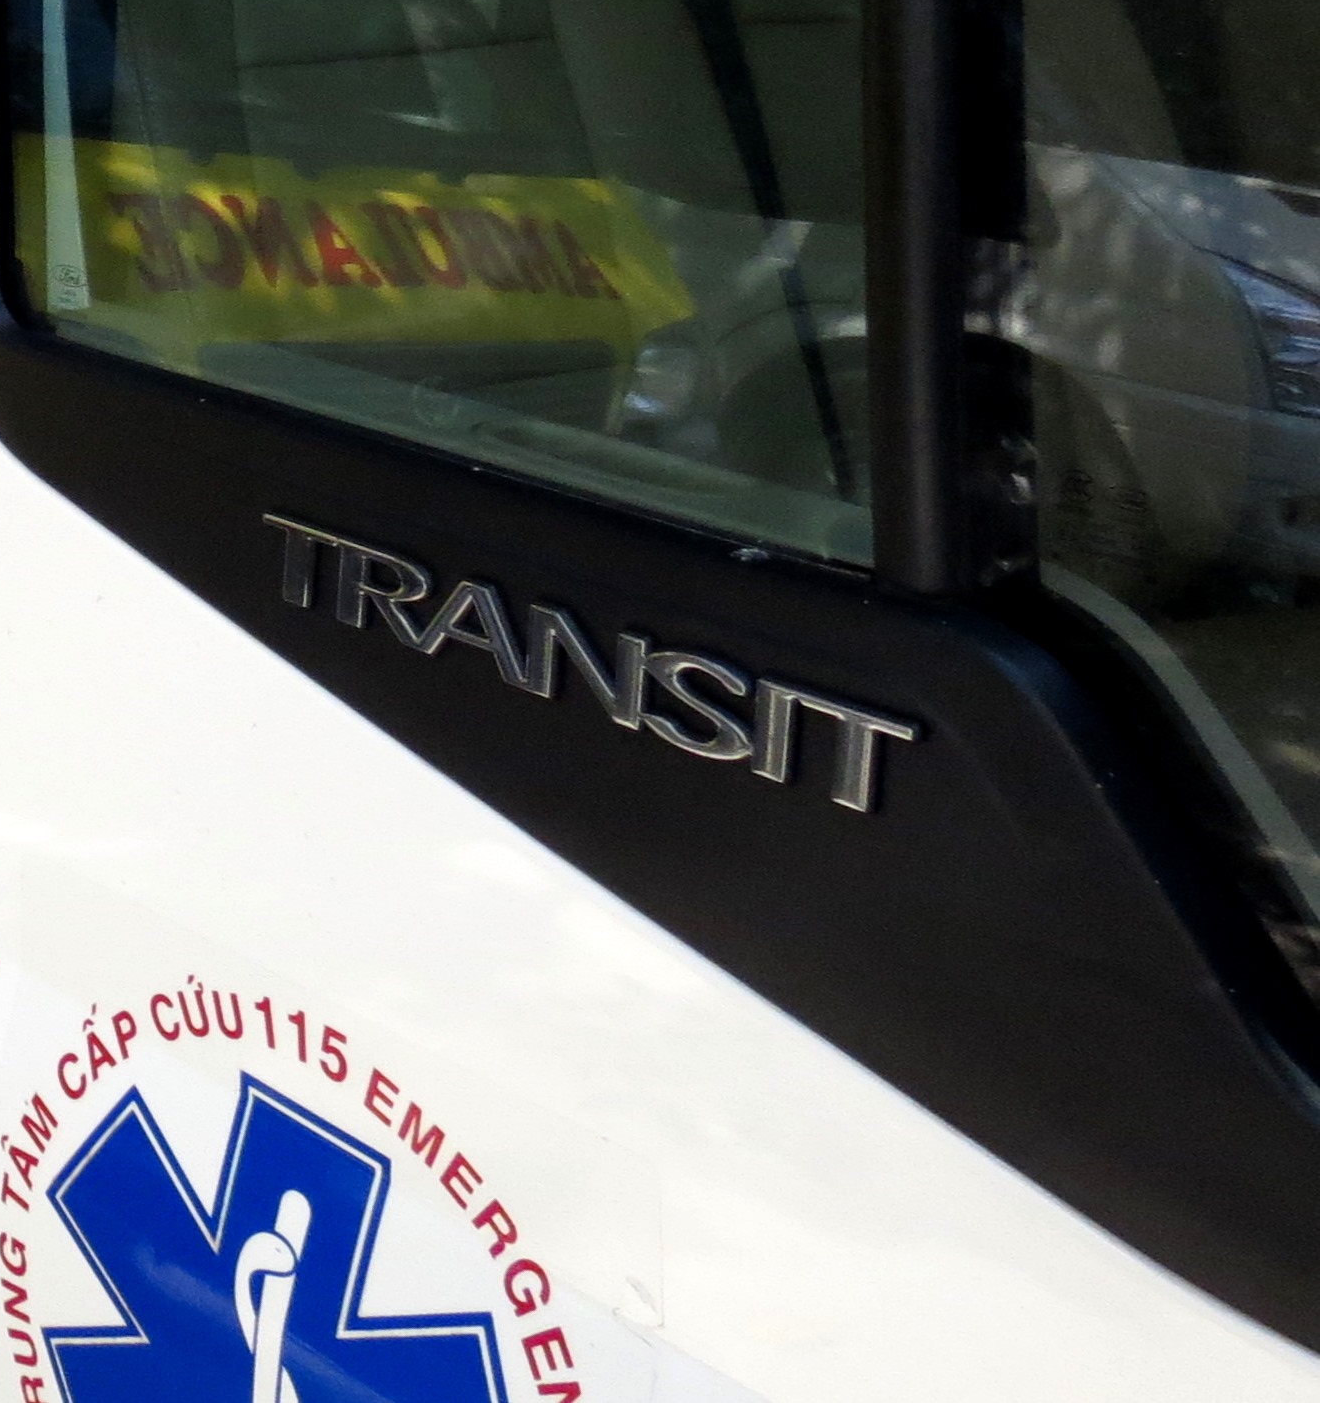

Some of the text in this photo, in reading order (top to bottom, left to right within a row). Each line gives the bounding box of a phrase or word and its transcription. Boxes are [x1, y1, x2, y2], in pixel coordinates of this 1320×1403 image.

[262, 512, 918, 813] TRANSIT
[0, 1091, 60, 1213] TÂM
[56, 1003, 138, 1100] CẤP
[149, 974, 244, 1041] CỨU
[253, 996, 348, 1083] 115
